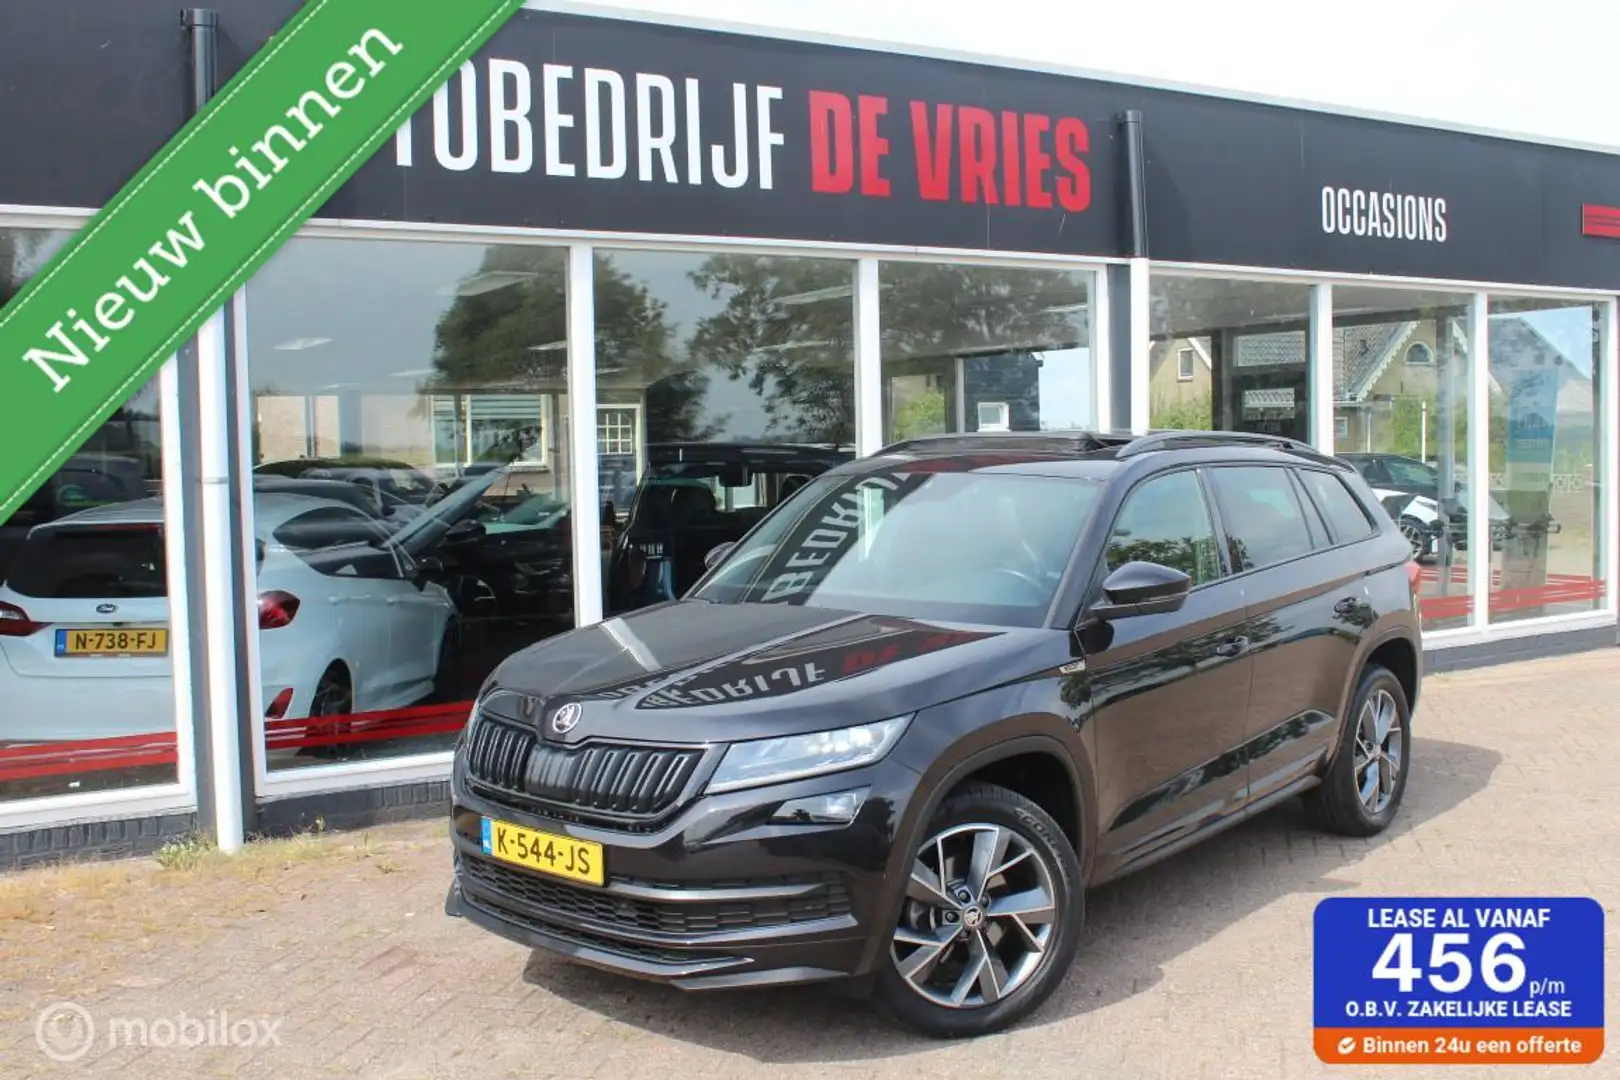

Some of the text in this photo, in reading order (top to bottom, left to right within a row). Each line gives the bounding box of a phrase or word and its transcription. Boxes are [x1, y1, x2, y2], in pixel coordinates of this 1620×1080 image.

[808, 90, 891, 198] DE
[909, 100, 1092, 213] VRIES
[1321, 185, 1447, 243] OCCASIONS
[75, 631, 157, 650] N-738-FJ
[496, 826, 591, 875] K-544-JS
